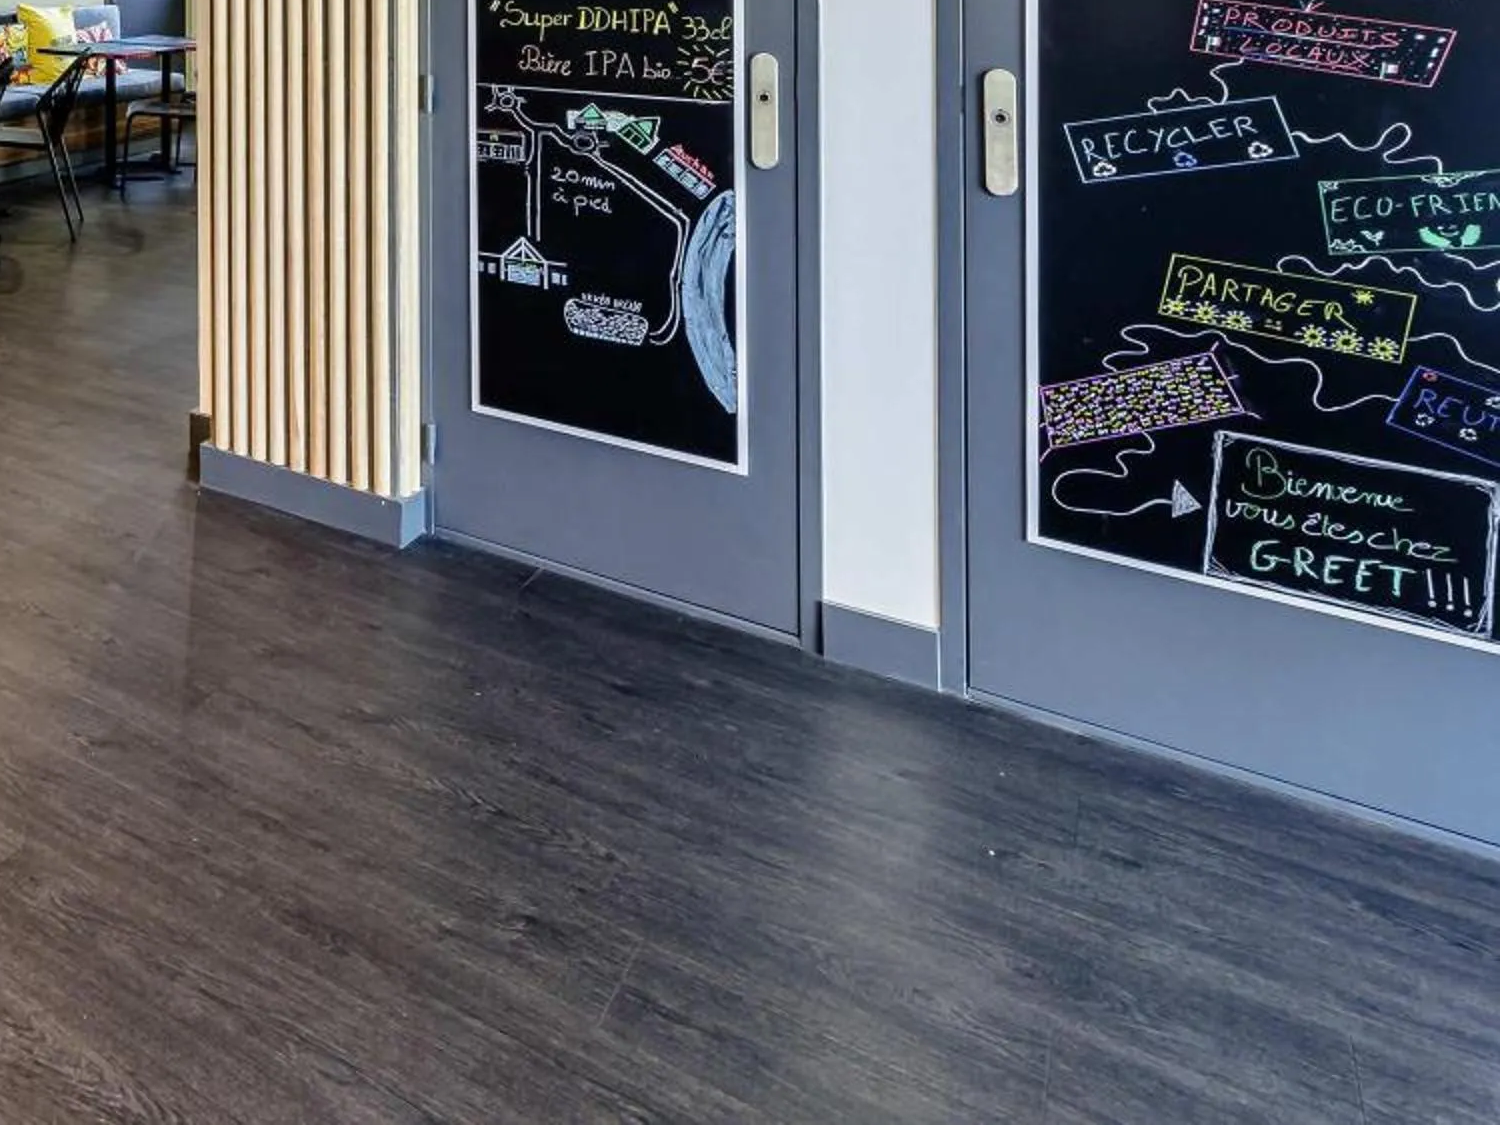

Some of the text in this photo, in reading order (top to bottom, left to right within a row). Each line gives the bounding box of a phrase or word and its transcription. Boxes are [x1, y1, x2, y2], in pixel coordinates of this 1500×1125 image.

[1221, 6, 1402, 48] PRODUITS
[518, 43, 573, 76] Bière
[584, 50, 636, 79] IPA
[1238, 36, 1372, 69] LOCAUX
[1080, 115, 1259, 163] RECYCLER
[1176, 265, 1359, 331] PARTAGER
[1240, 447, 1415, 513] Bienvenue
[1225, 497, 1297, 530] vous
[1366, 527, 1459, 564] chez
